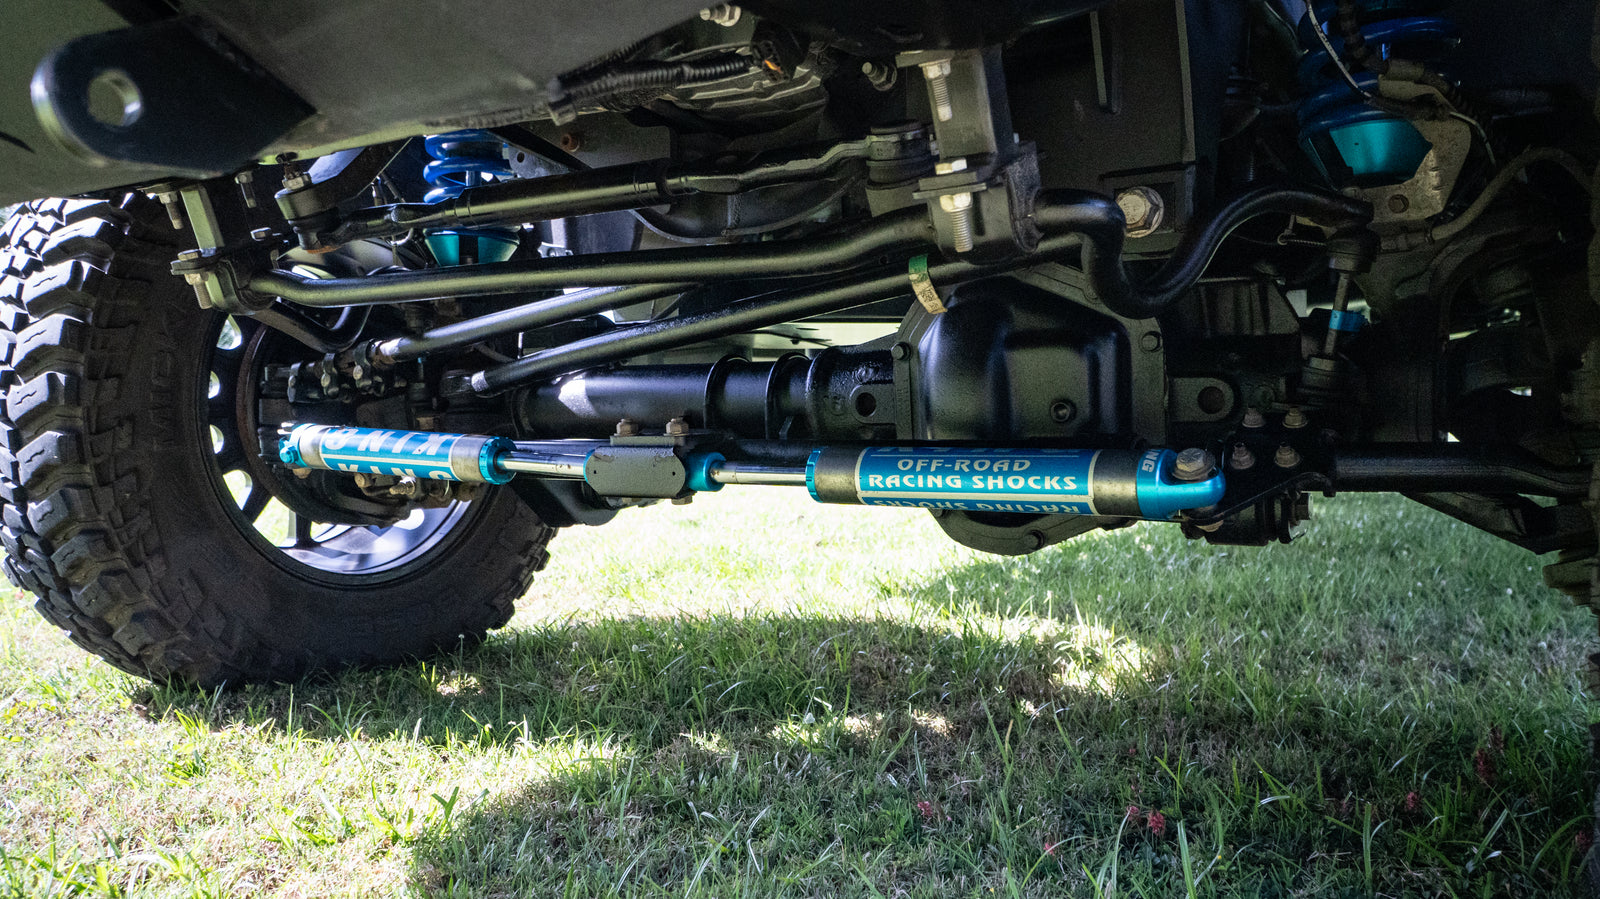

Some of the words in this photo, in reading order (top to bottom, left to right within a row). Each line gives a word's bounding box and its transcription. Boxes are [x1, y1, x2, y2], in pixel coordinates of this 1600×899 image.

[325, 428, 453, 456] KING
[897, 459, 1031, 473] OFF-ROAD
[868, 474, 962, 489] RACING
[971, 475, 1078, 491] SHOCKS
